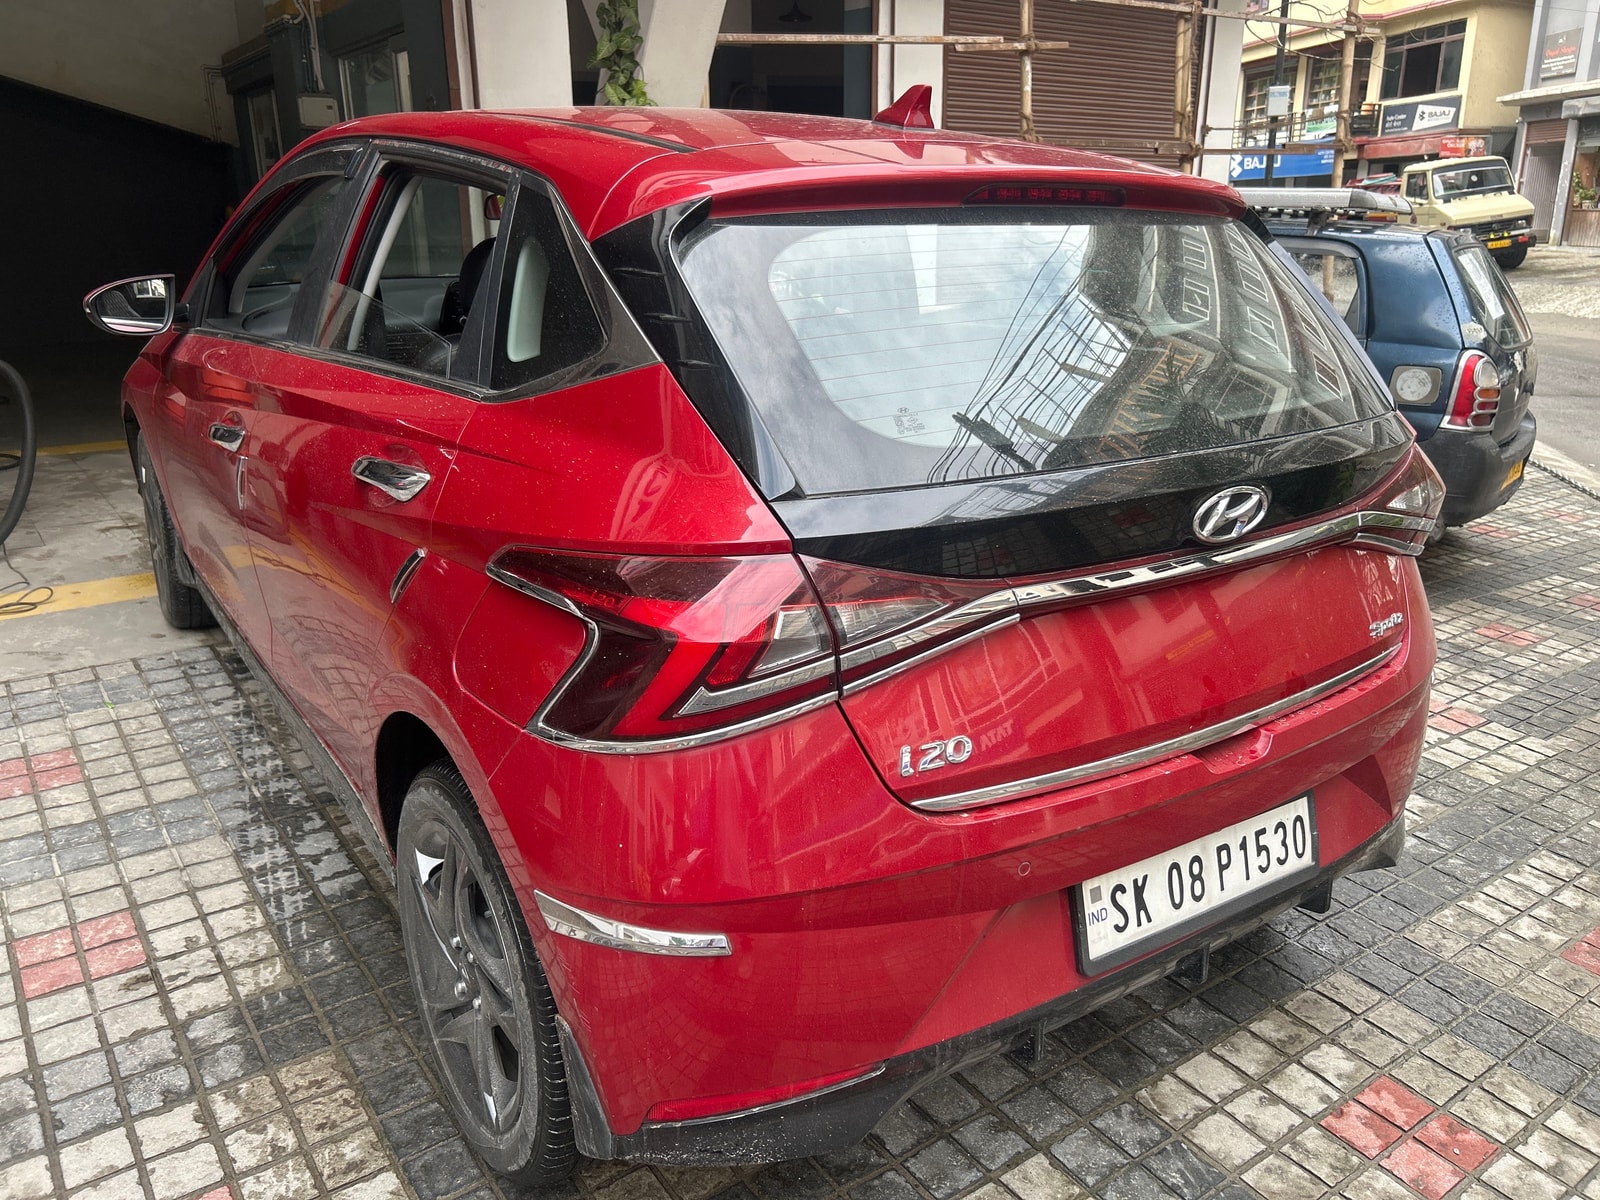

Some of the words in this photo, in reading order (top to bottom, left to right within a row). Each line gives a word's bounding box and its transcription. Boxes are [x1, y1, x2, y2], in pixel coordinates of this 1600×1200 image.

[1243, 154, 1281, 169] BAJJ
[1110, 874, 1152, 933] SK
[1167, 855, 1206, 910] 08
[1216, 814, 1307, 892] P1530
[1088, 907, 1108, 926] IND
